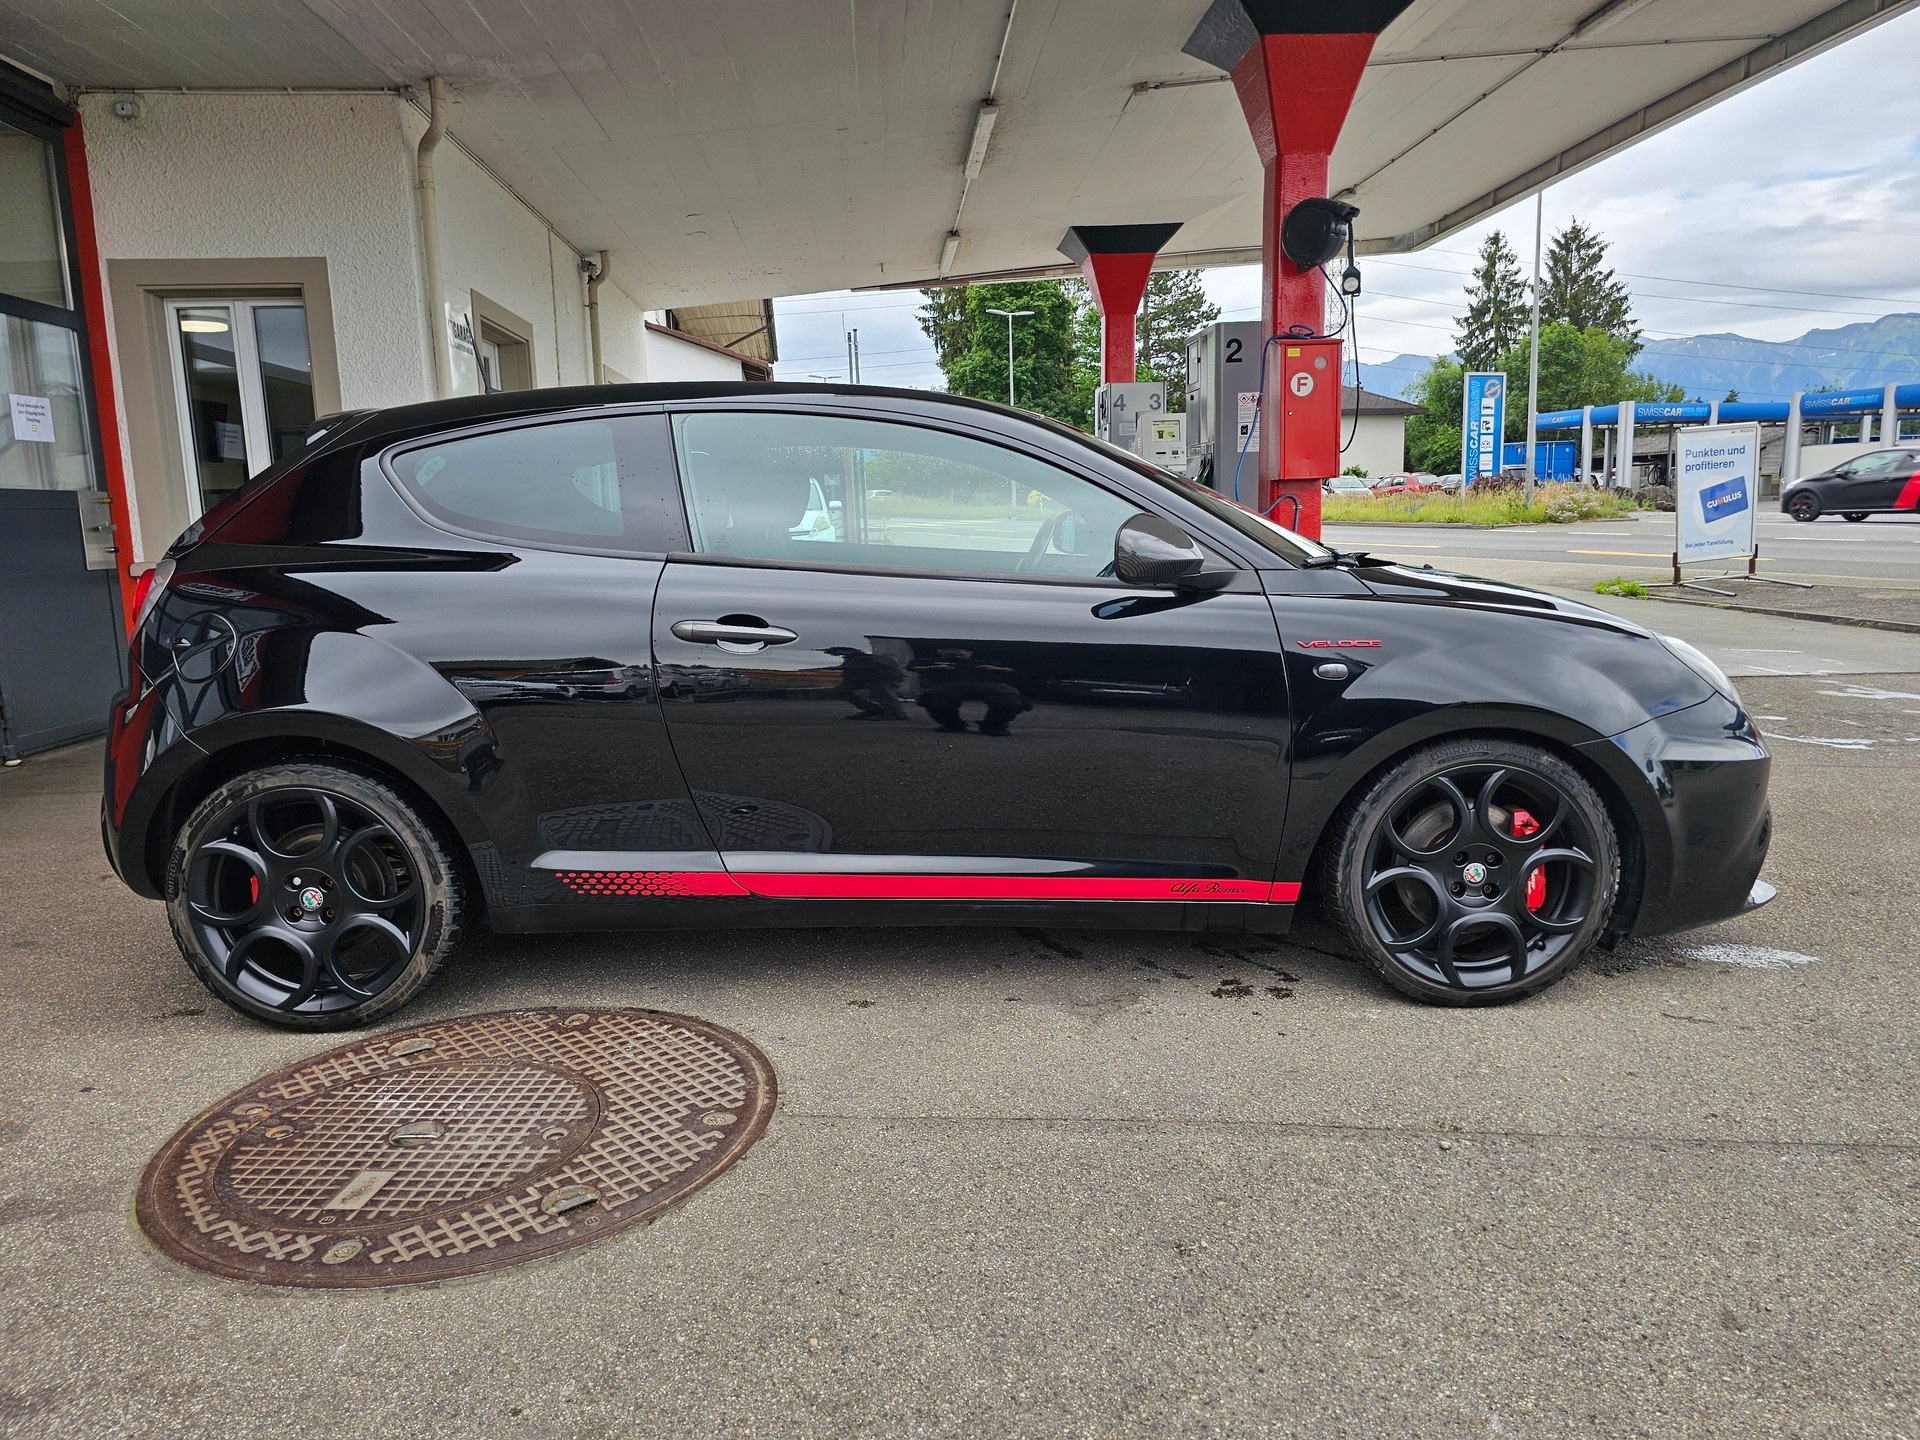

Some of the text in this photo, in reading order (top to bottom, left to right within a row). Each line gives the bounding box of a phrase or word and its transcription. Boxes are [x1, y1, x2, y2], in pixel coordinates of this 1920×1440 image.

[1225, 338, 1243, 363] 2
[1296, 376, 1308, 392] F
[1113, 393, 1162, 411] 4 3
[1685, 444, 1746, 459] Punkten und
[1685, 460, 1735, 474] profitieren
[1706, 490, 1742, 509] CUMULUS
[1685, 541, 1694, 549] Bei
[1296, 639, 1382, 649] VELOCE
[1430, 743, 1490, 760] UNIROYAL
[1170, 882, 1250, 897] Alfa Romeo
